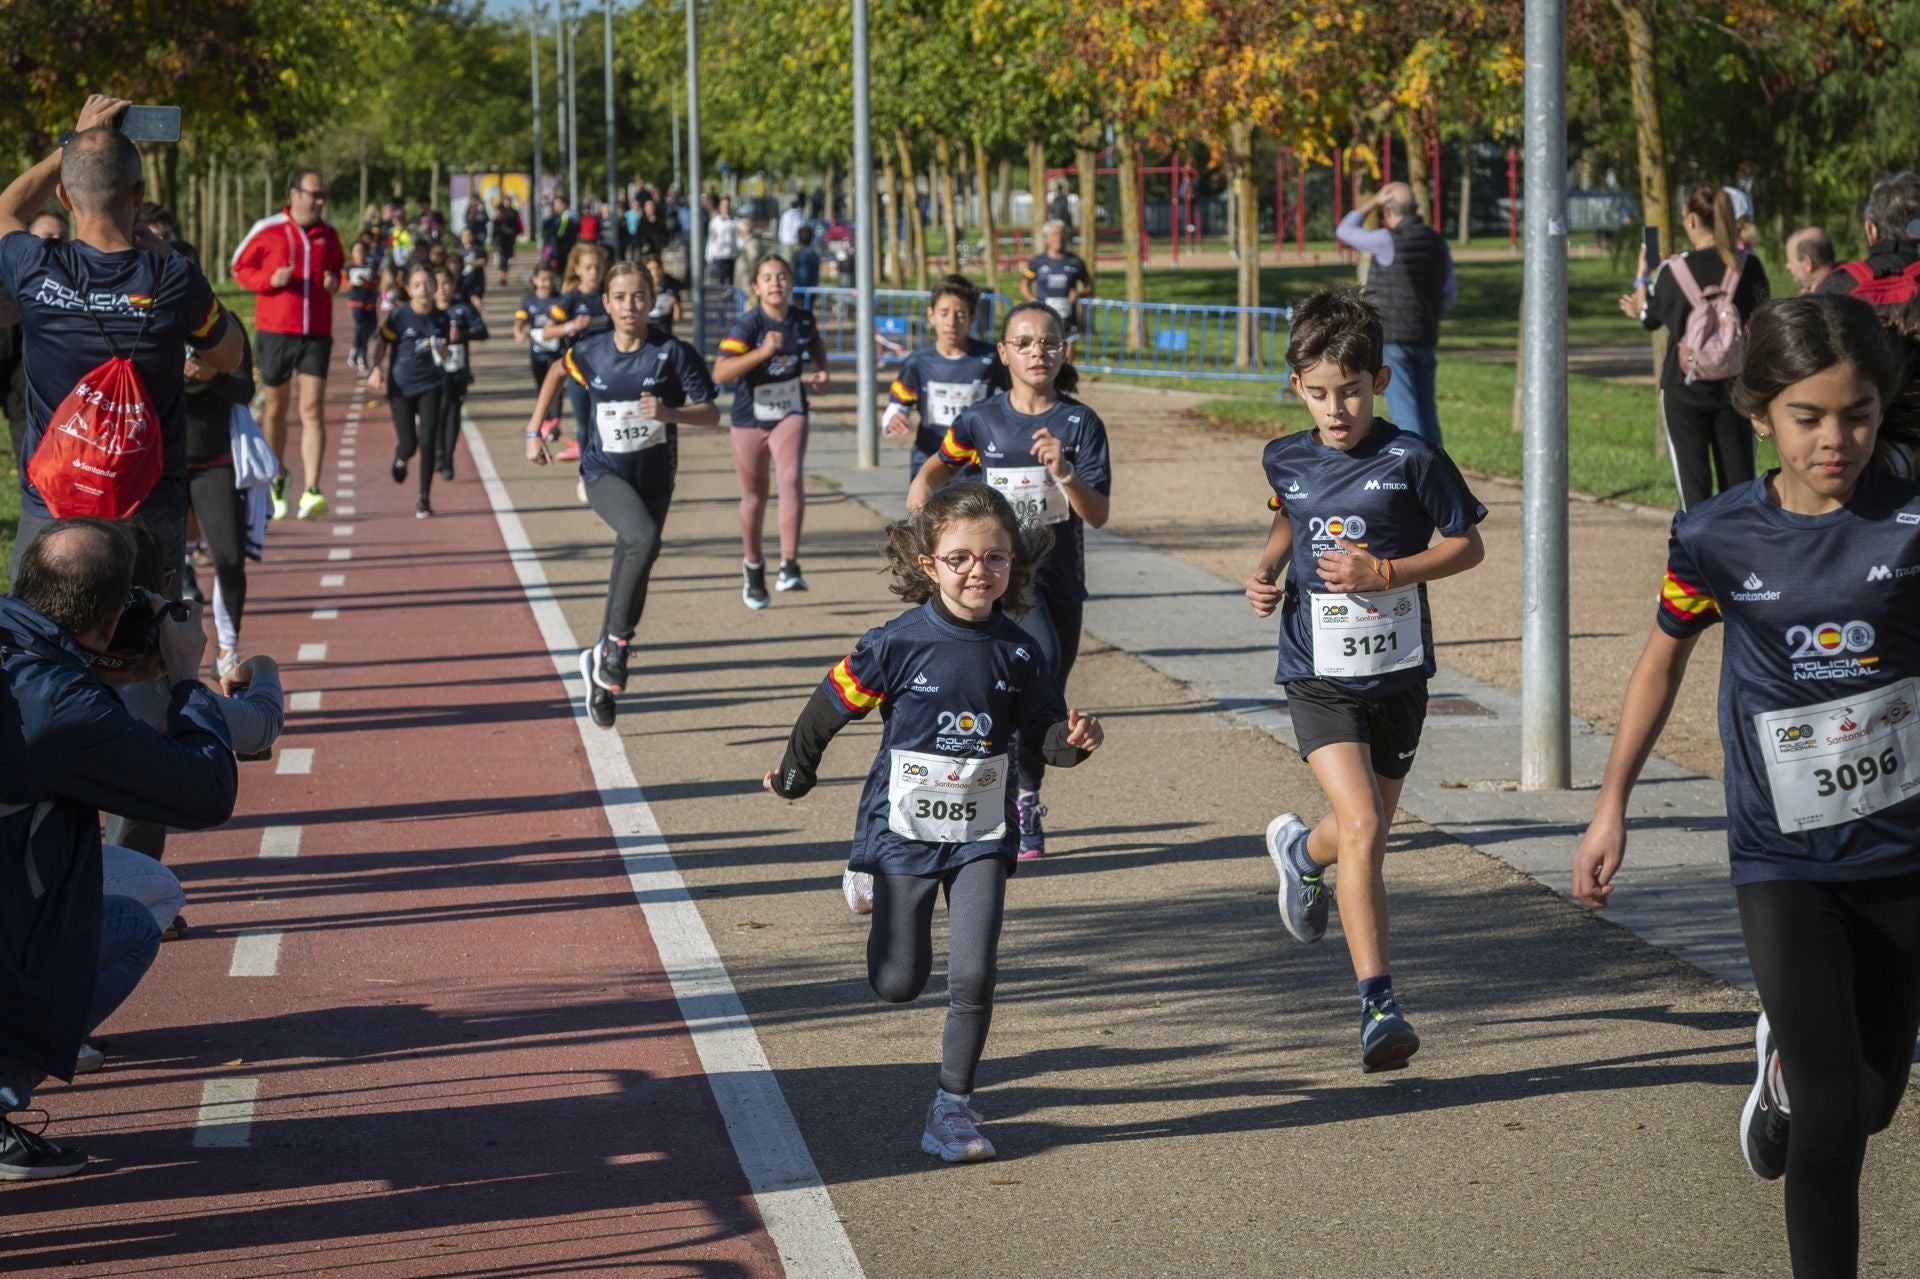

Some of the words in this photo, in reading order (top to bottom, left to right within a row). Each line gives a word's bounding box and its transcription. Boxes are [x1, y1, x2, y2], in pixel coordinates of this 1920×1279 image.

[42, 278, 132, 306] POLICIA
[614, 426, 650, 441] 3132
[1011, 498, 1047, 514] 061
[1731, 591, 1781, 601] Santander
[1322, 606, 1348, 616] 200
[1343, 632, 1398, 657] 3121
[1785, 620, 1876, 659] 200
[1792, 658, 1862, 671] POLICIA
[1793, 667, 1880, 681] NACIONAL
[937, 711, 993, 737] 200
[936, 737, 984, 745] POLICIA
[1776, 724, 1814, 743] 200
[1826, 727, 1874, 746] Santander
[902, 763, 929, 777] 200
[1813, 746, 1898, 797] 3096
[934, 780, 970, 790] Santander
[915, 799, 977, 822] 3085
